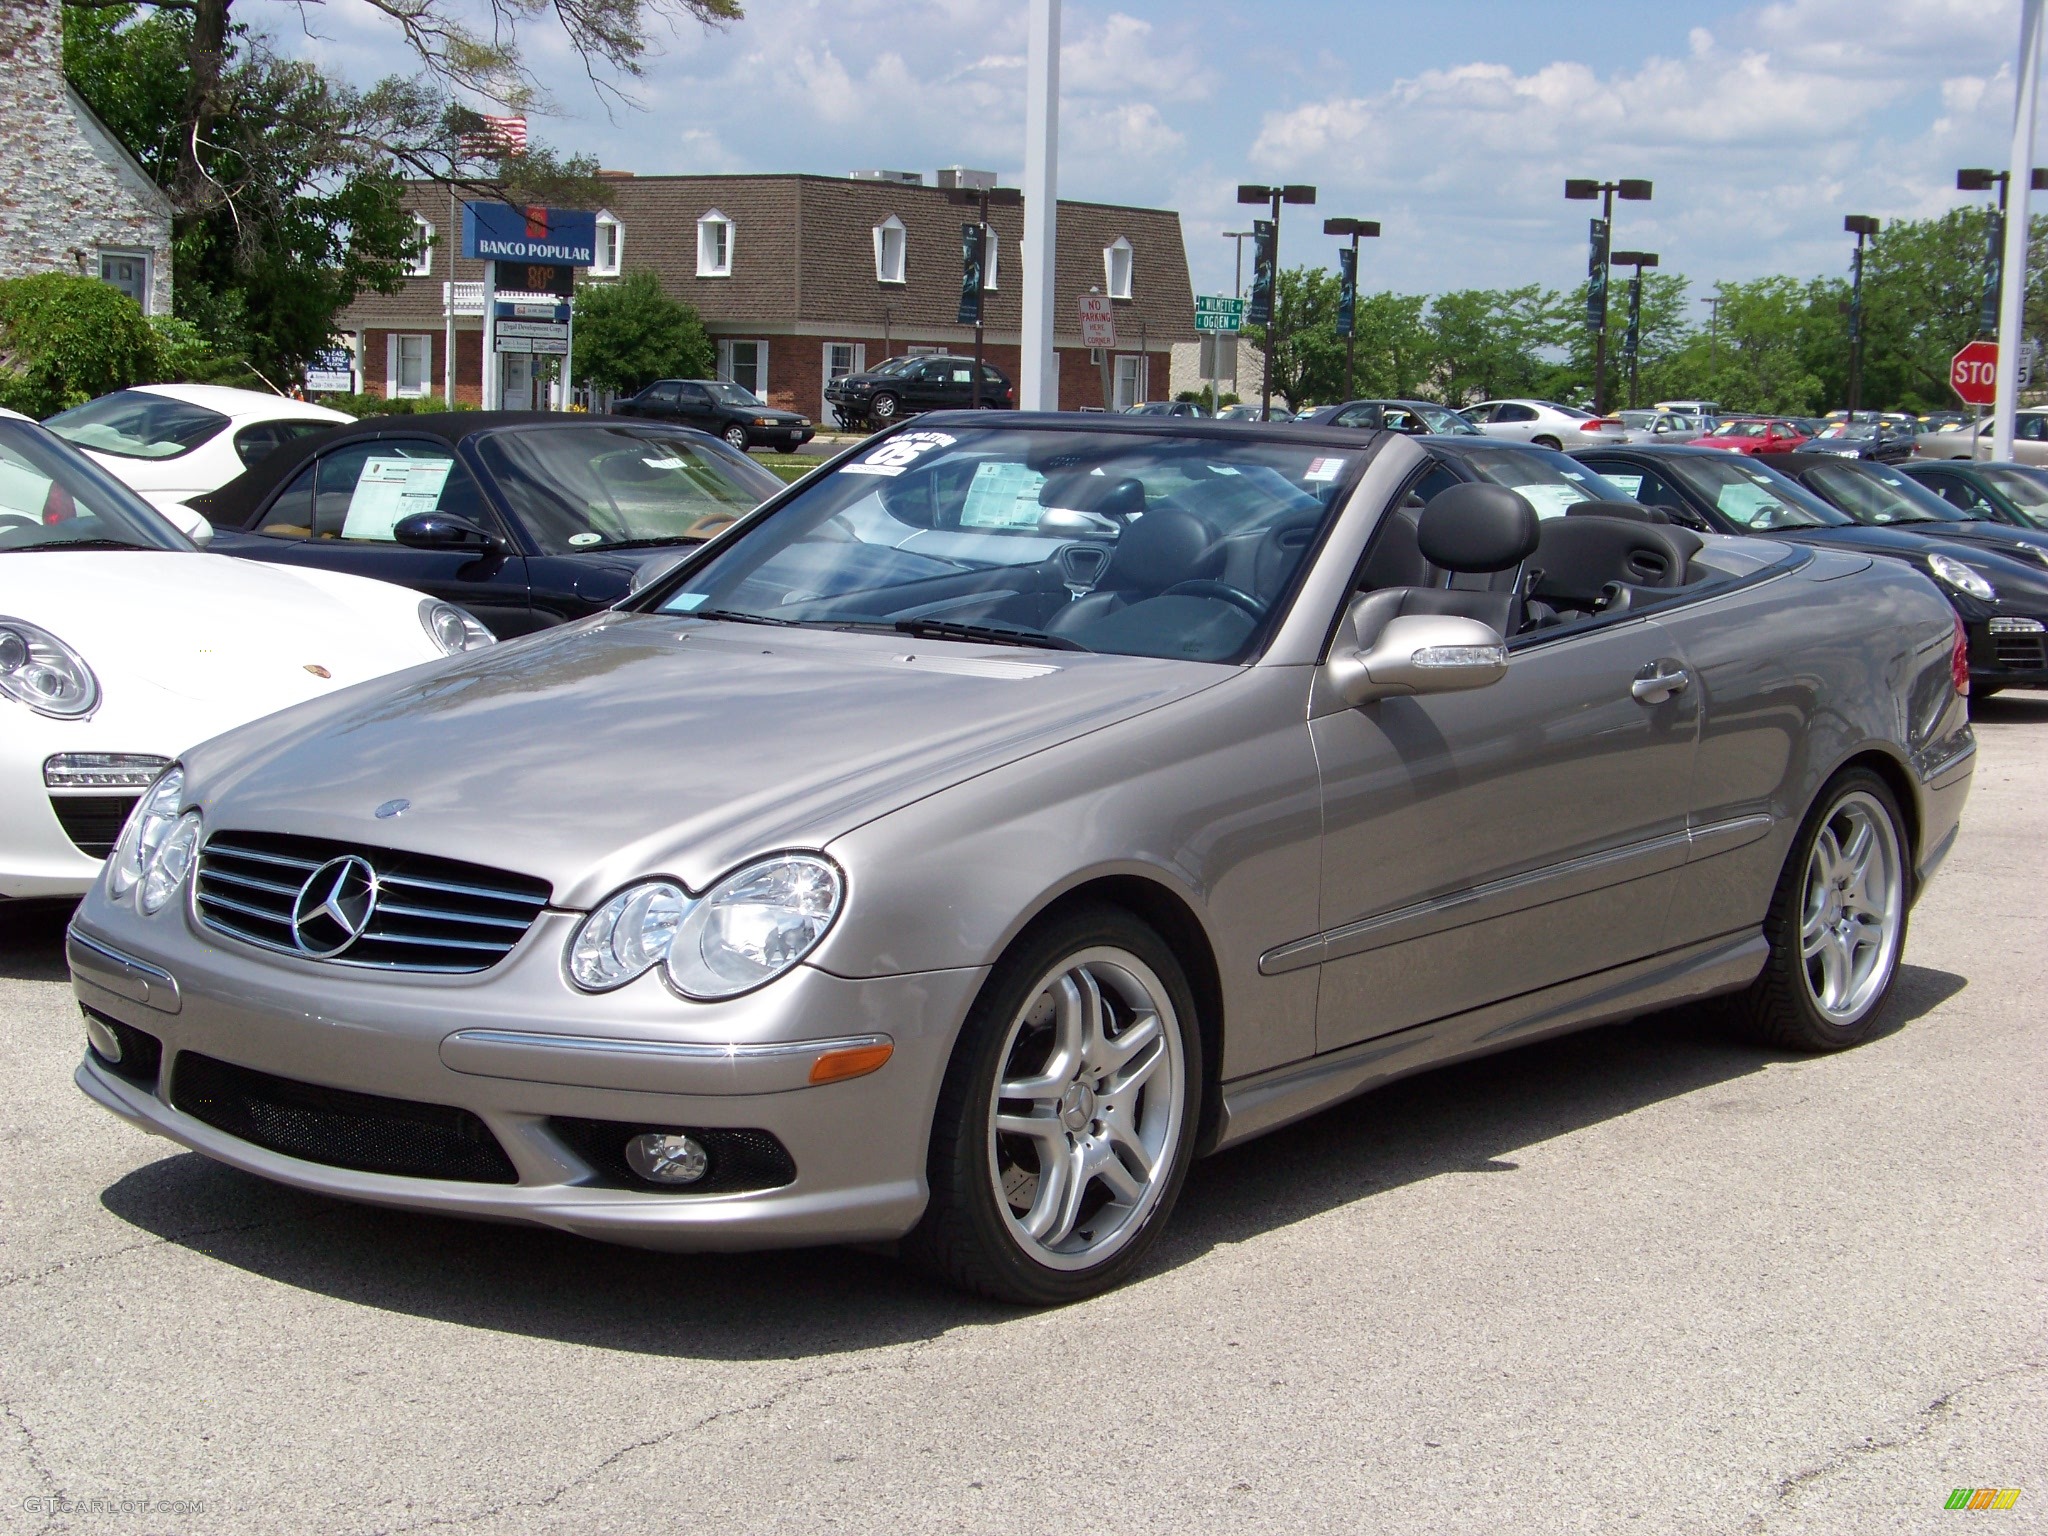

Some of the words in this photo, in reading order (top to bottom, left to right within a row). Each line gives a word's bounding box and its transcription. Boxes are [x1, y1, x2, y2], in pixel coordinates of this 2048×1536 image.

[480, 239, 526, 256] BANCO
[528, 243, 590, 260] POPULAR
[1088, 300, 1101, 311] NO
[1205, 298, 1235, 313] WILMETTE
[1081, 312, 1111, 322] PARKING
[1203, 315, 1229, 329] OGDEN
[518, 323, 549, 332] Development
[1089, 323, 1105, 331] HERE
[1087, 336, 1111, 344] CORNER
[1955, 360, 1995, 385] STO
[2017, 366, 2028, 383] 5
[864, 441, 937, 466] 05
